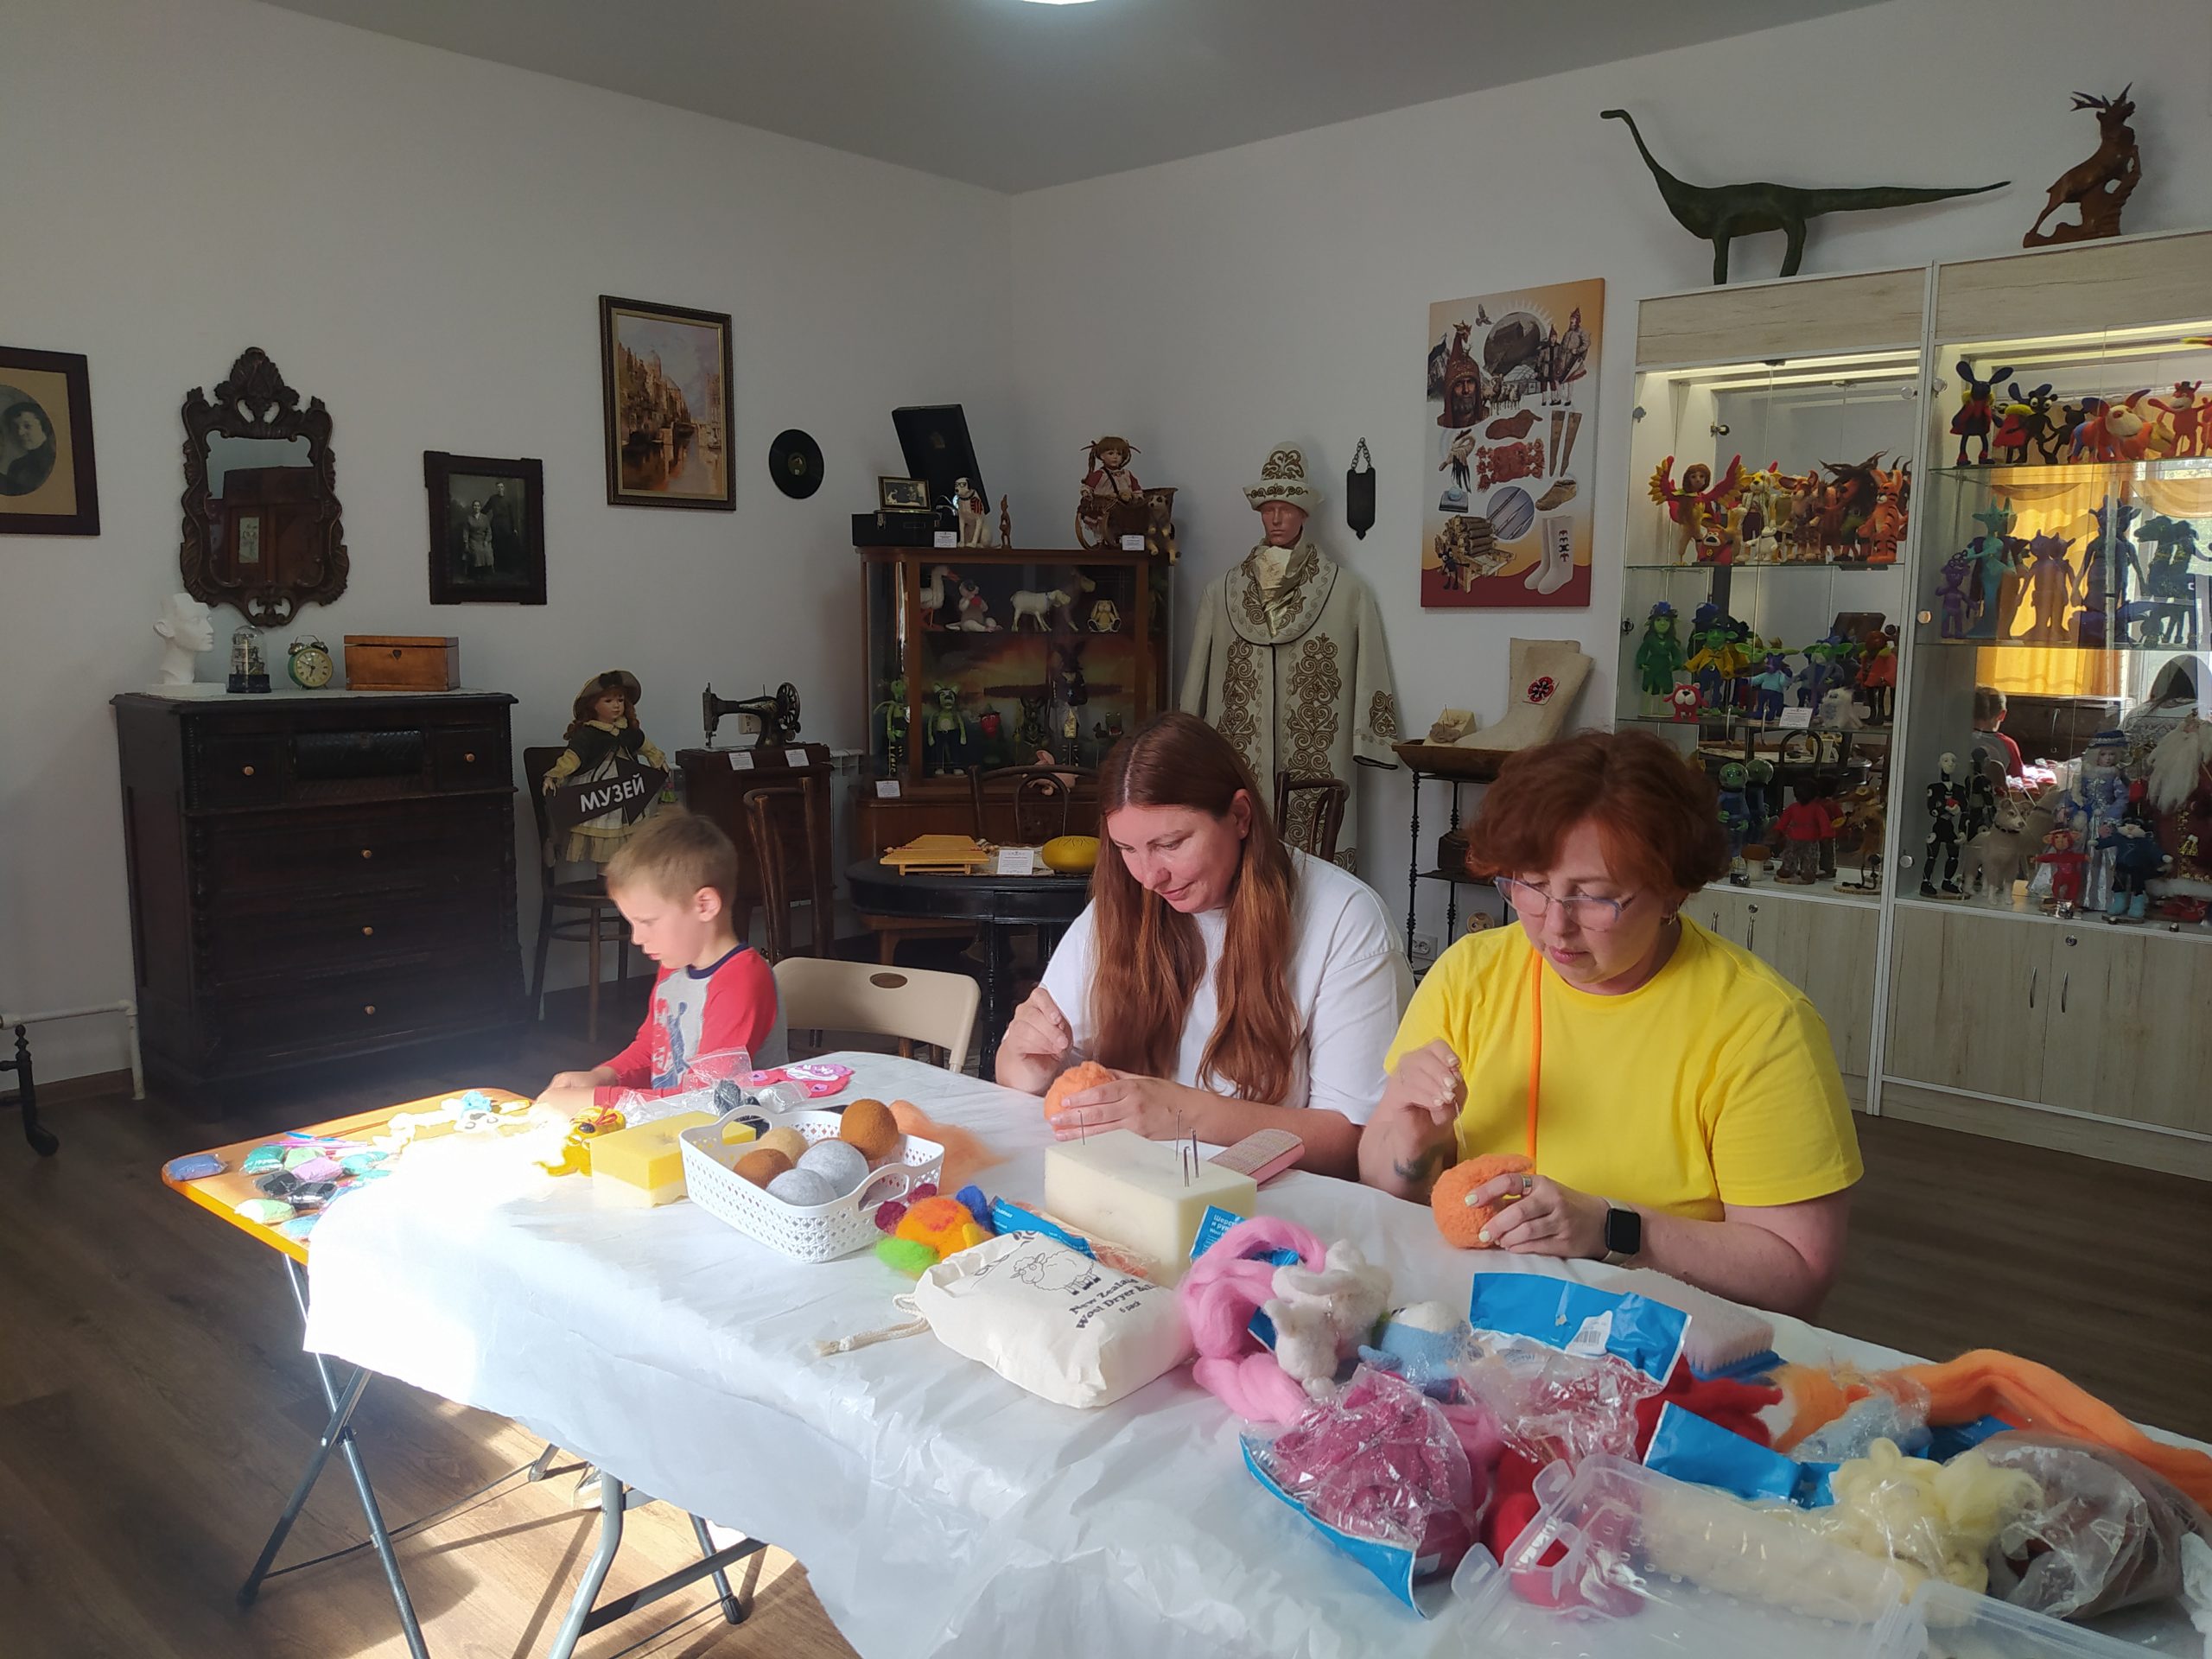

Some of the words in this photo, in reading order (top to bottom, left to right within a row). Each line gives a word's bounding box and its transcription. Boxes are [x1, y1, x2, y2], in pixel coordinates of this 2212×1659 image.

[580, 772, 645, 812] МУЗЕЙ
[1069, 1298, 1096, 1314] New
[1076, 1305, 1105, 1328] Wool
[1103, 1288, 1135, 1307] Dryer
